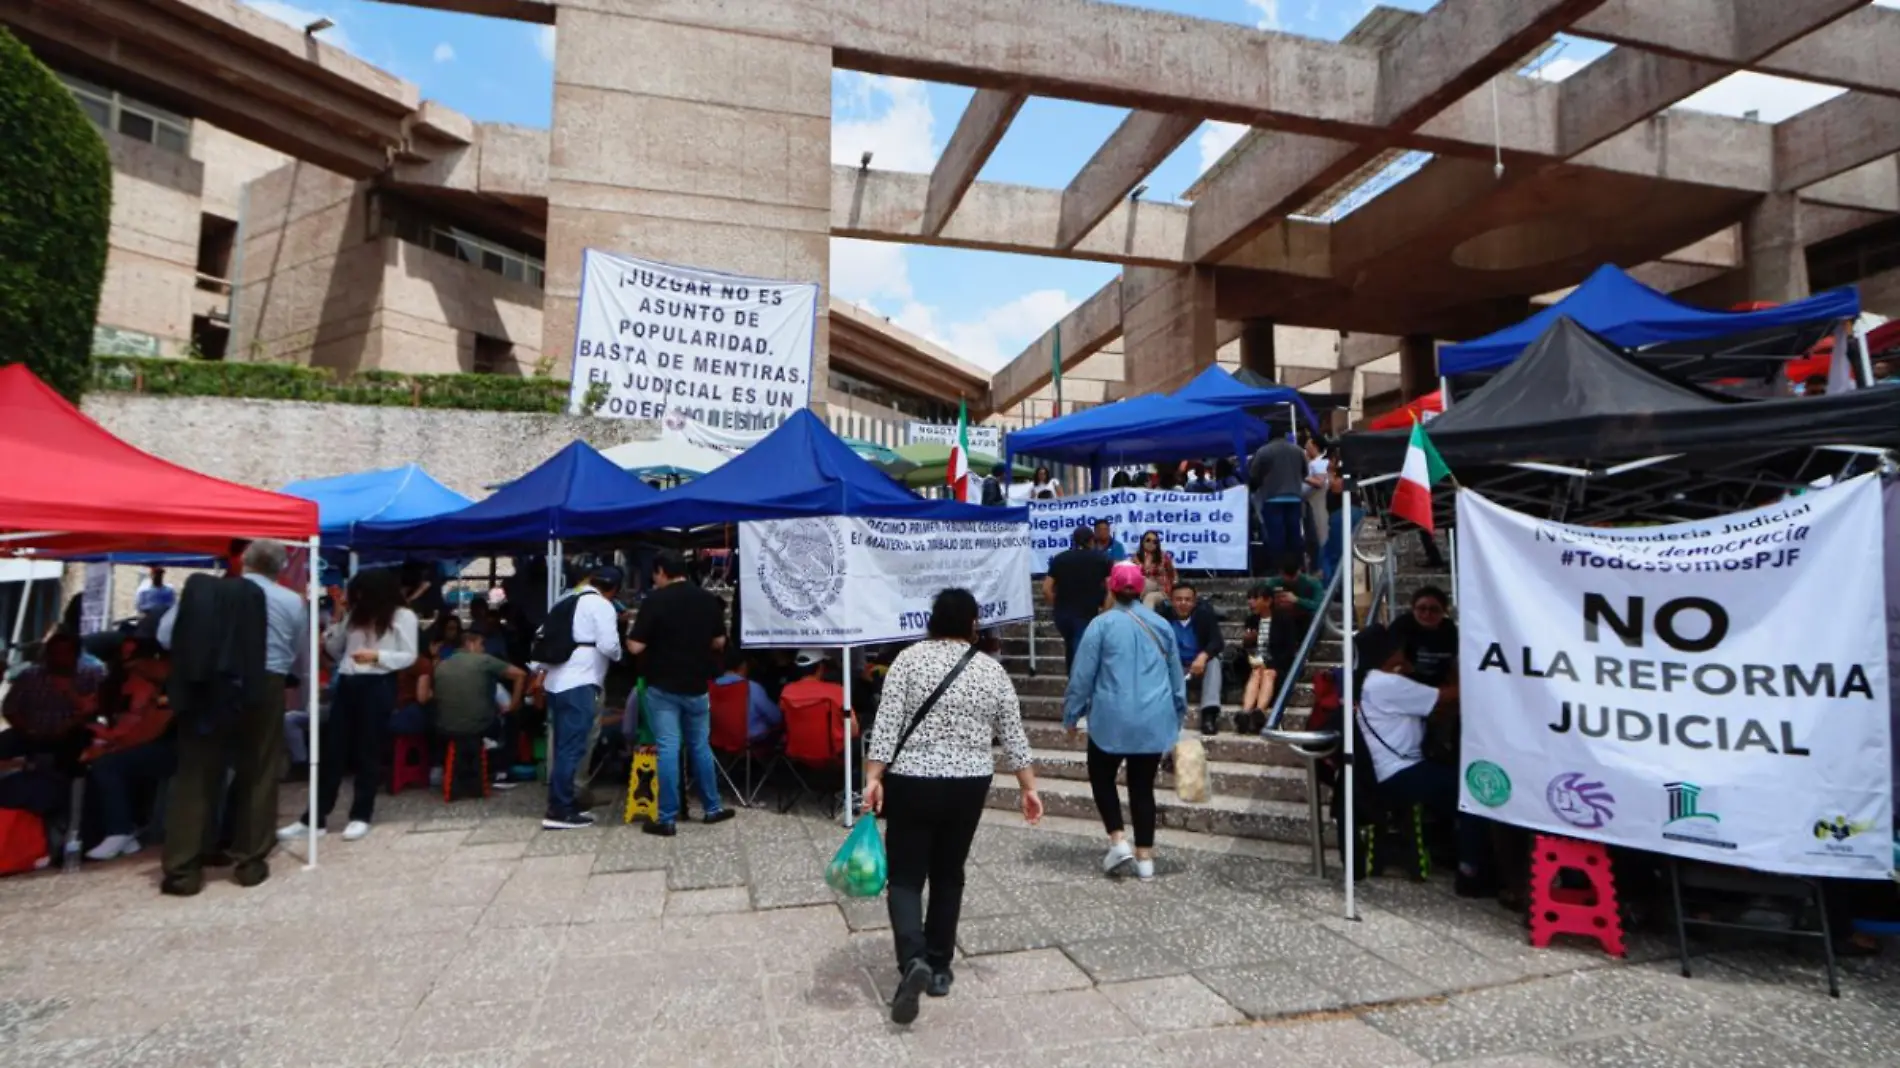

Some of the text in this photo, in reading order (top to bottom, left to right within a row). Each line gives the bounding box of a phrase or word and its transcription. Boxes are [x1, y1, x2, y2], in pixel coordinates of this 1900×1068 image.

[722, 284, 749, 300] NO
[759, 289, 782, 306] ES
[639, 297, 759, 328] ASUNTO DE
[619, 319, 774, 356] POPULARIDAD.
[580, 340, 806, 385] BASTA DE MENTIRAS.
[623, 373, 722, 401] JUDICIAL
[732, 387, 756, 404] ES
[766, 390, 794, 408] UN
[595, 397, 666, 418] ODER
[1027, 513, 1097, 531] olegiado
[1129, 509, 1201, 523] Materia
[1208, 509, 1234, 523] de
[1721, 503, 1811, 534] Judicial
[1031, 534, 1075, 550] rabaj
[1656, 524, 1810, 557] democracia
[1583, 592, 1730, 652] NO
[1478, 642, 1875, 700] A LA REFORMA
[1548, 701, 1810, 757] JUDICIAL
